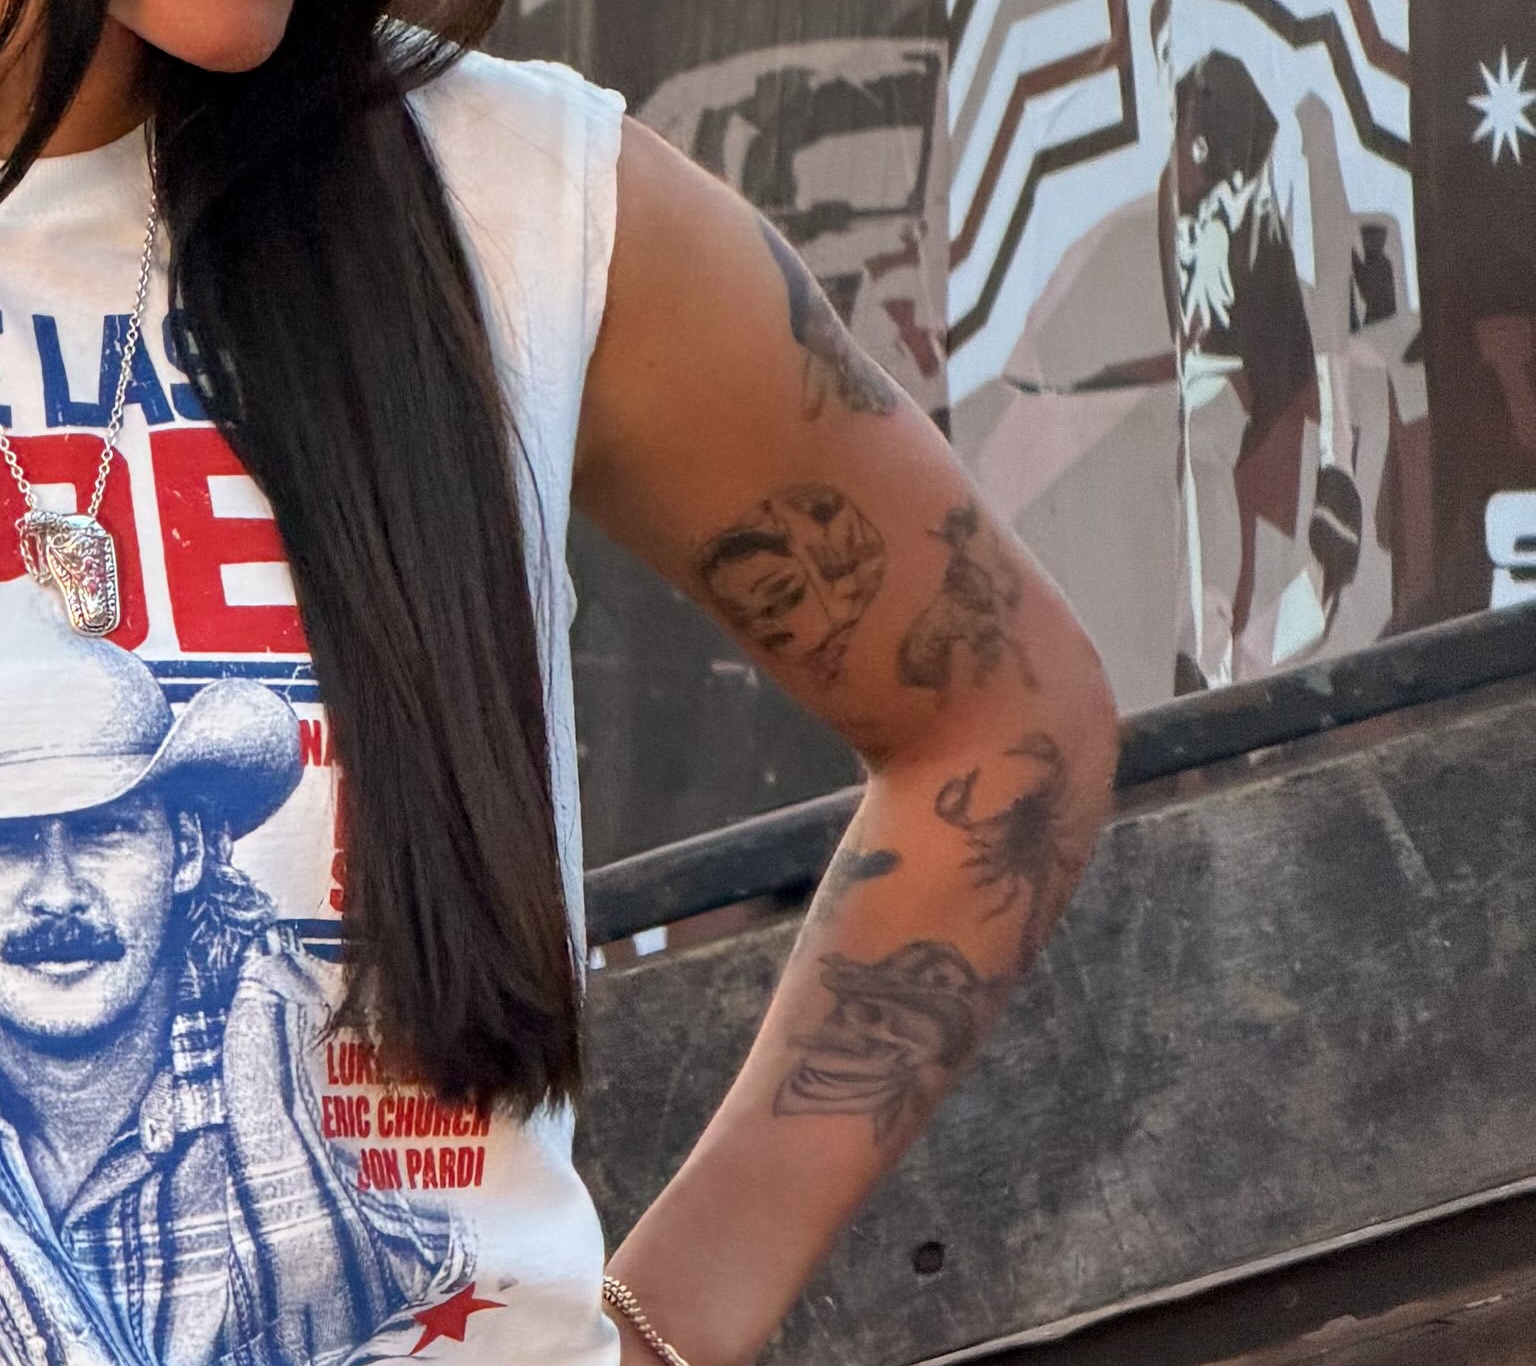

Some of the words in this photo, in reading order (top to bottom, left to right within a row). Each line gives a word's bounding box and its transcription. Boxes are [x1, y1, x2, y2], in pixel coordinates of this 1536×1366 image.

[327, 1041, 388, 1085] LUK
[322, 1095, 371, 1139] ERIC
[358, 1148, 403, 1192] JON
[406, 1146, 485, 1189] PARDI
